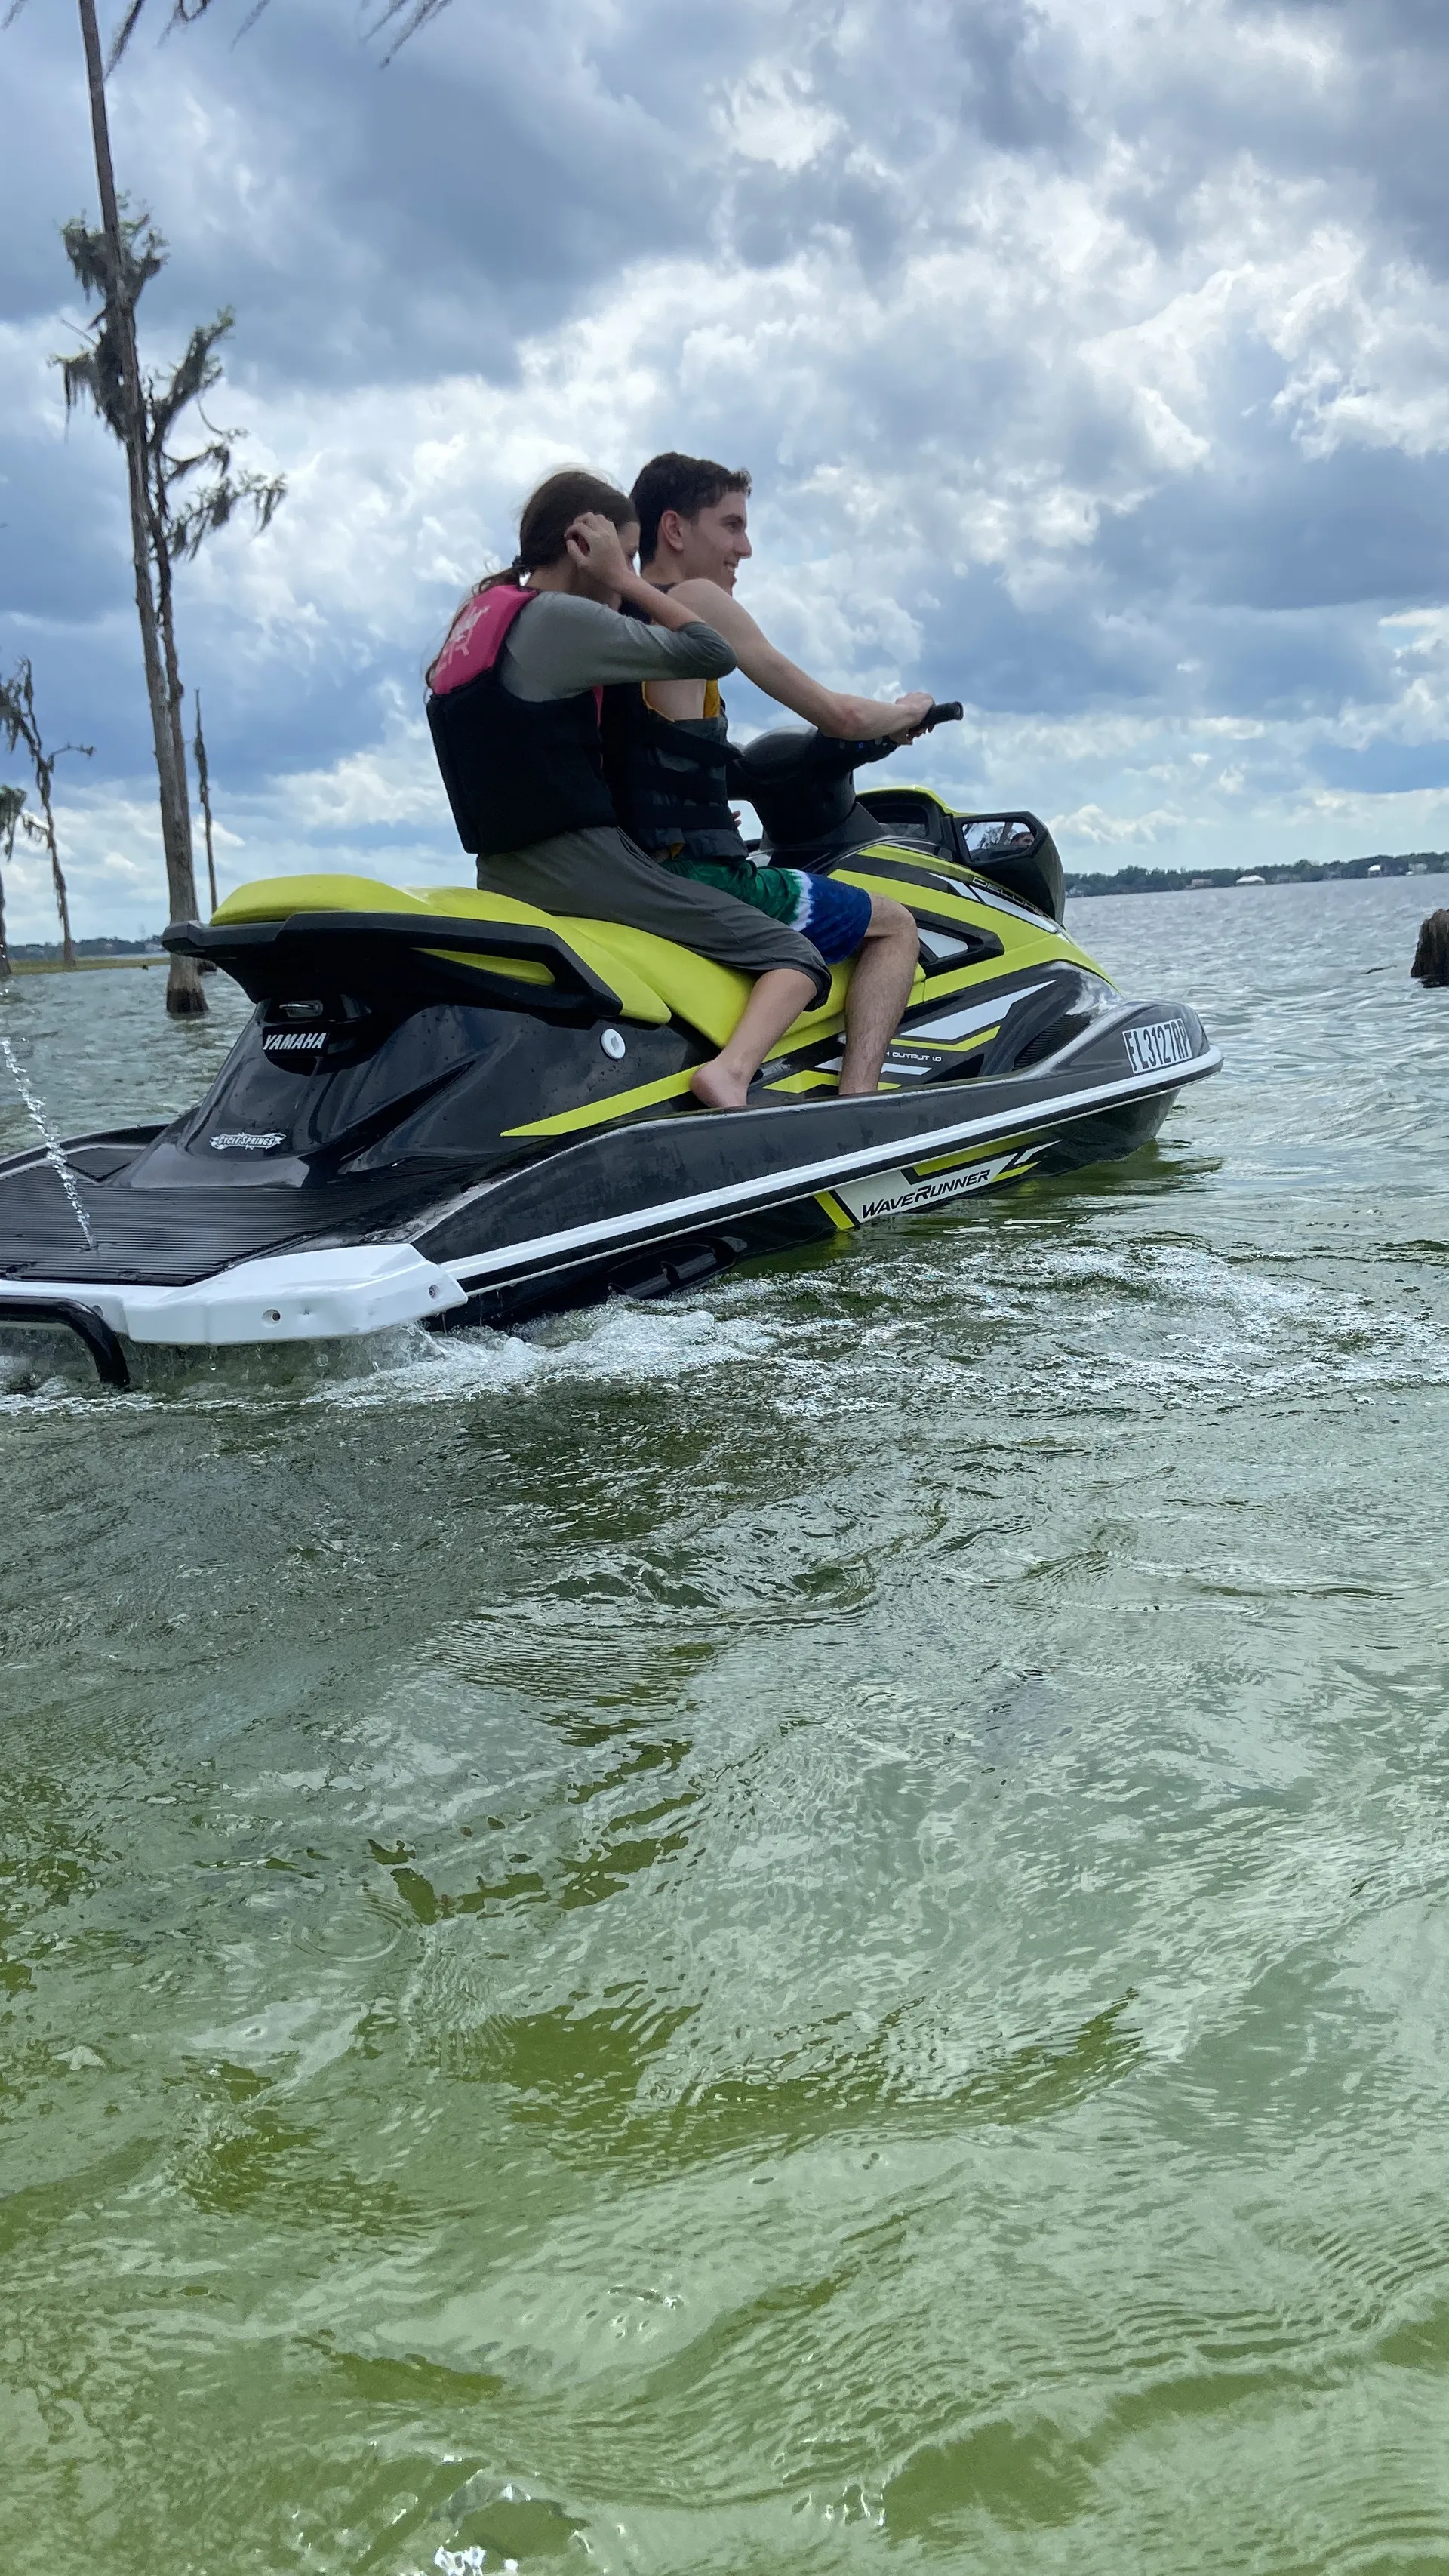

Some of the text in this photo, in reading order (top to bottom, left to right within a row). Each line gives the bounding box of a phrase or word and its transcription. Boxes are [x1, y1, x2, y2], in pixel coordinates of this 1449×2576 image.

[263, 1033, 327, 1050] YAMAHA
[1124, 1020, 1189, 1071] FL3127RP
[892, 1051, 930, 1061] OUTPUT
[218, 1135, 275, 1146] CYCLE SPRINGS
